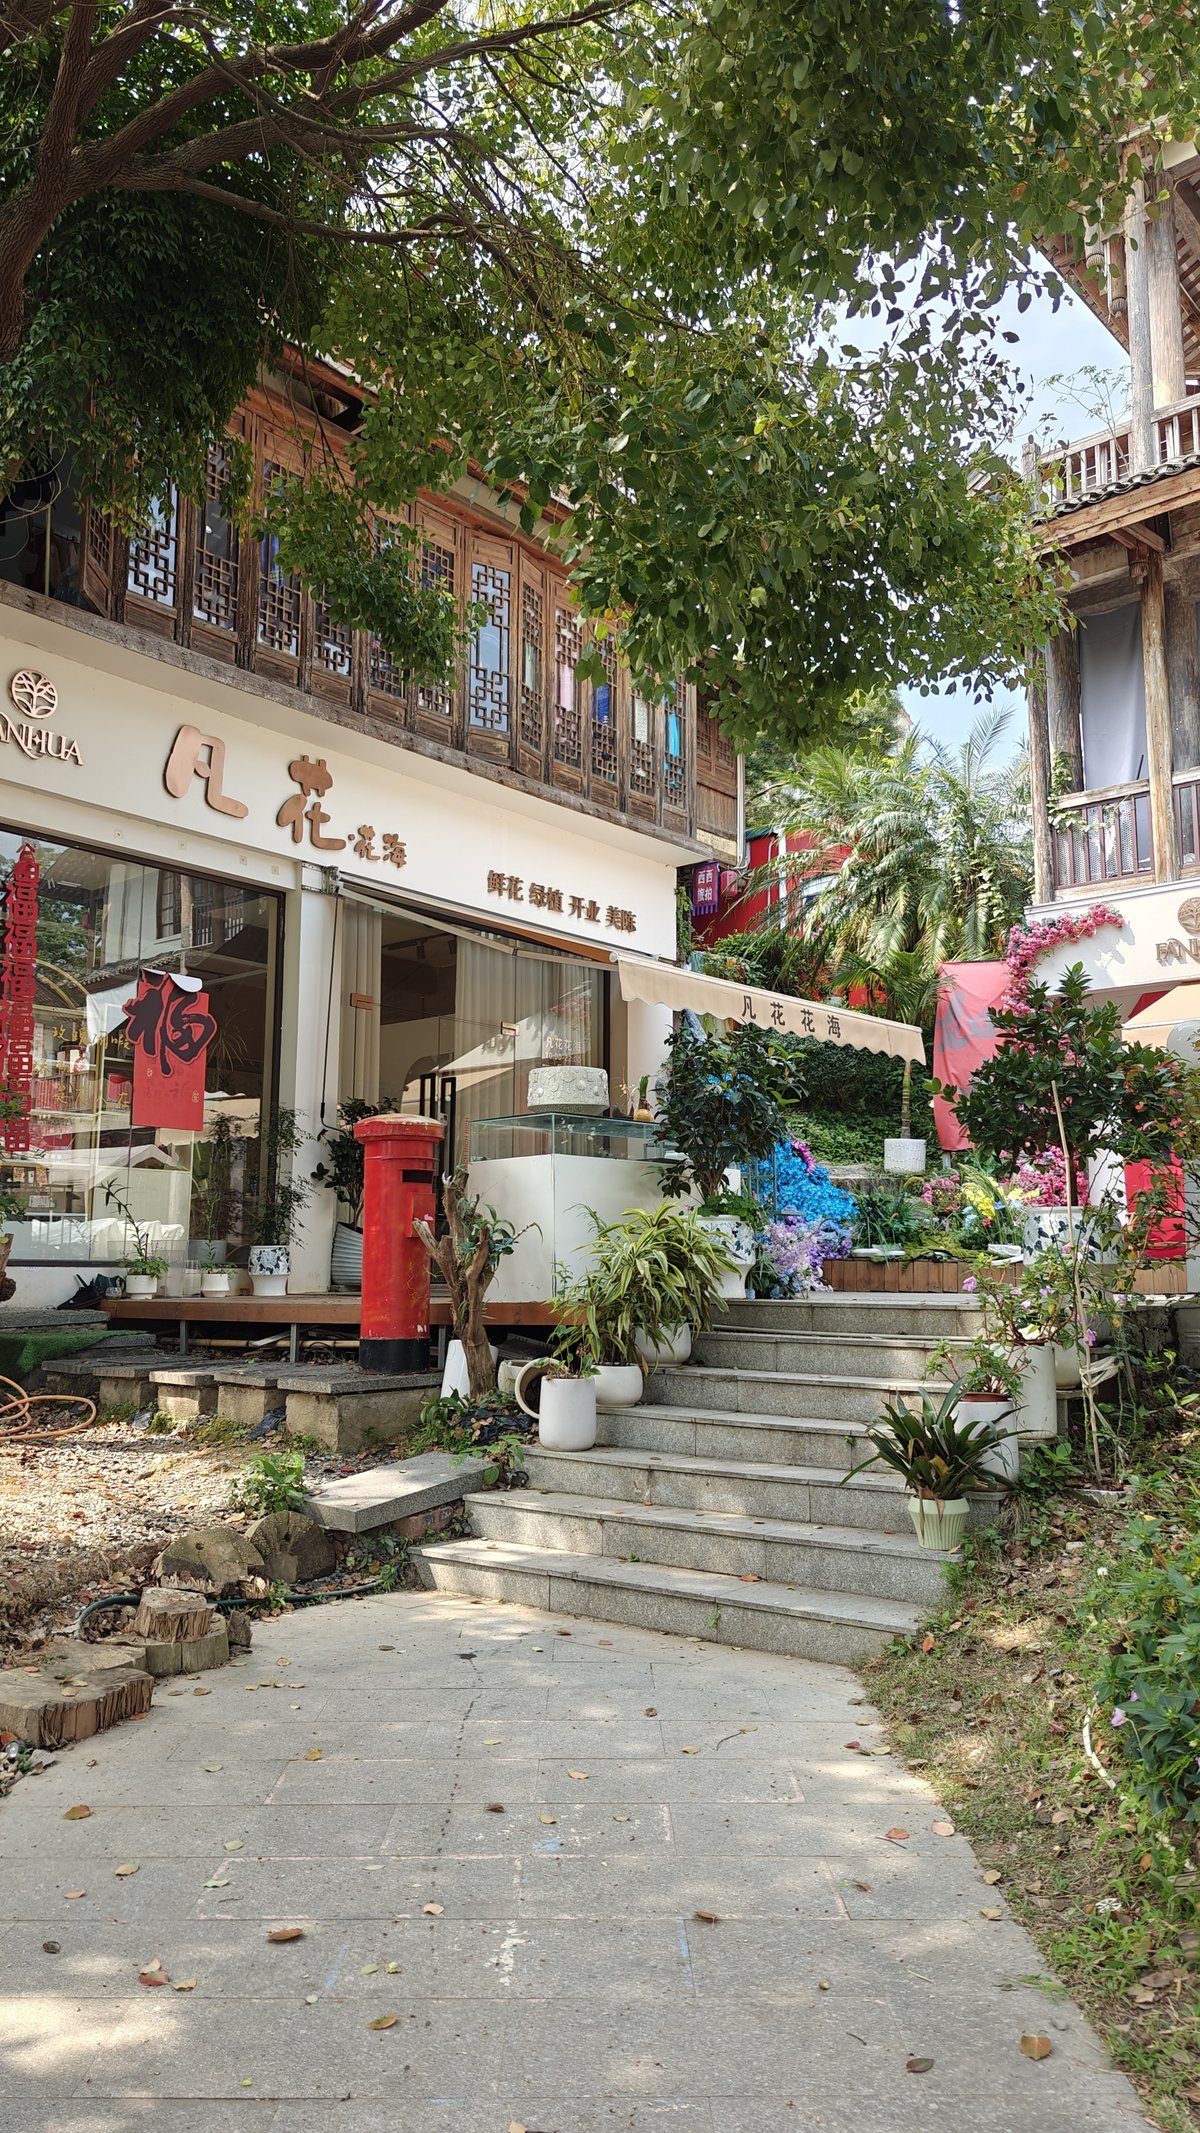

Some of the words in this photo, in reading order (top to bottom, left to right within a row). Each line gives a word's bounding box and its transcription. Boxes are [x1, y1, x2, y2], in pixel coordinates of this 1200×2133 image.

[487, 869, 525, 901] 鲜花
[528, 882, 564, 913] 绿植
[568, 895, 601, 923] 开业
[605, 905, 637, 933] 美陈
[128, 970, 216, 1077] 福
[742, 994, 842, 1039] 凡花花海
